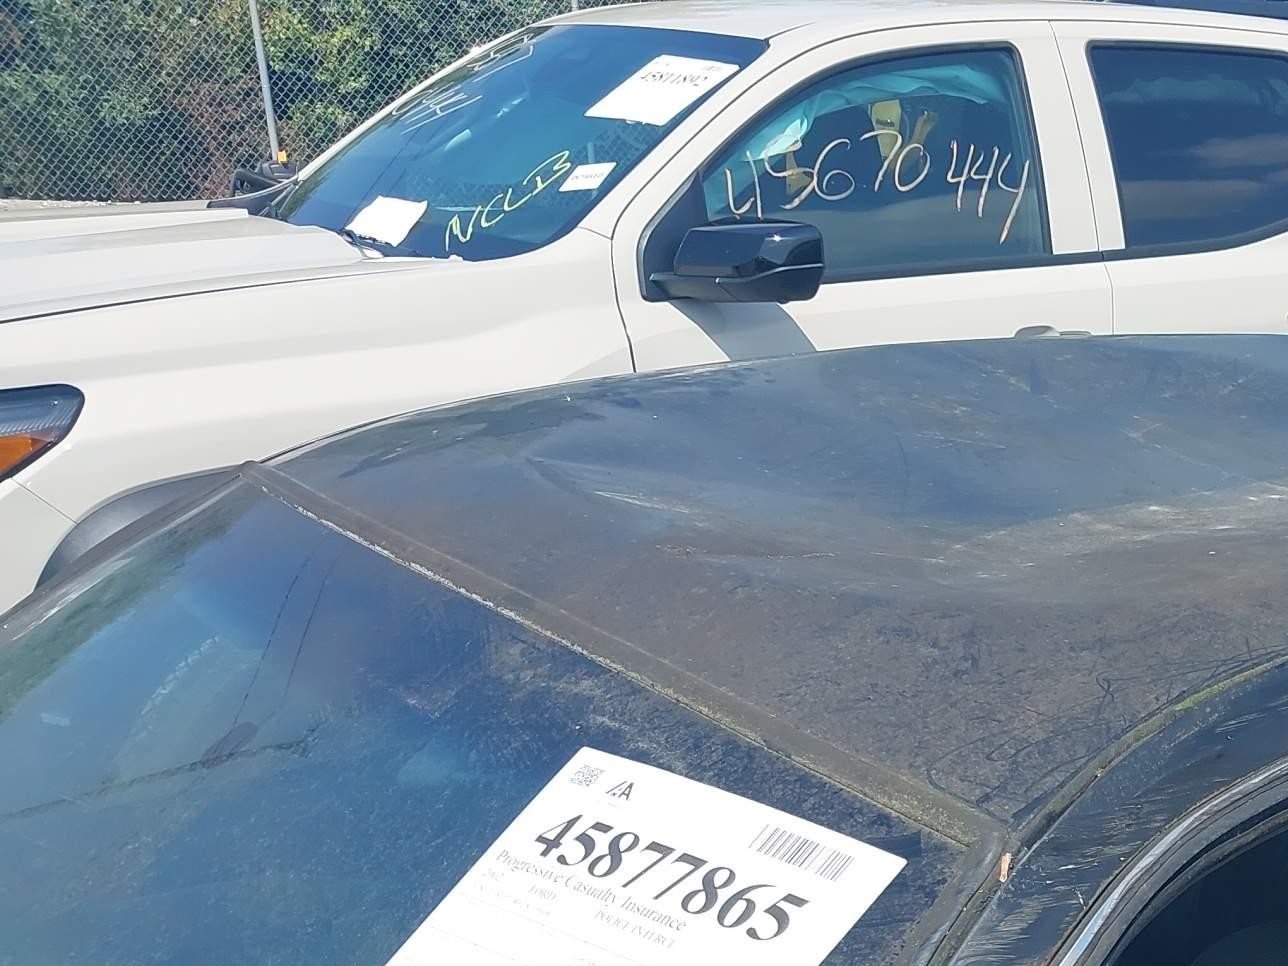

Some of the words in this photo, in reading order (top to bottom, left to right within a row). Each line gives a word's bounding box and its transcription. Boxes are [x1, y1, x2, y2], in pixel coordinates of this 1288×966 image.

[496, 849, 564, 883] Progressive
[564, 873, 617, 907] Casualty
[621, 896, 688, 931] Insurance
[535, 814, 811, 941] 45877865
